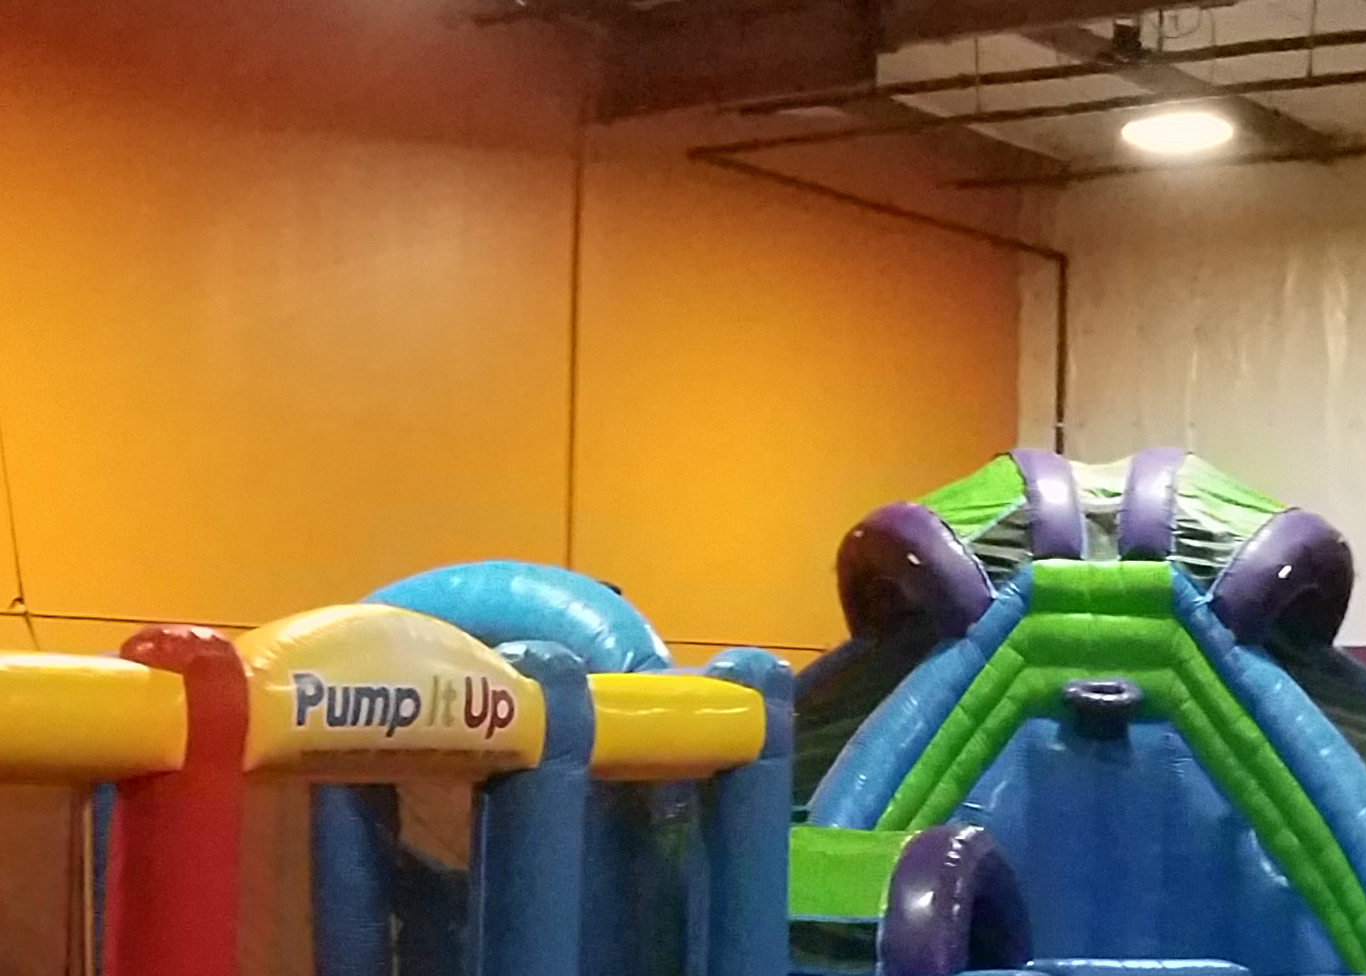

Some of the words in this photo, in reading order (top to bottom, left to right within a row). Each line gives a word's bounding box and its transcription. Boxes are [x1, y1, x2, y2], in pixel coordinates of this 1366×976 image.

[292, 672, 421, 738] Pump
[426, 674, 457, 727] It
[463, 675, 515, 740] Up
